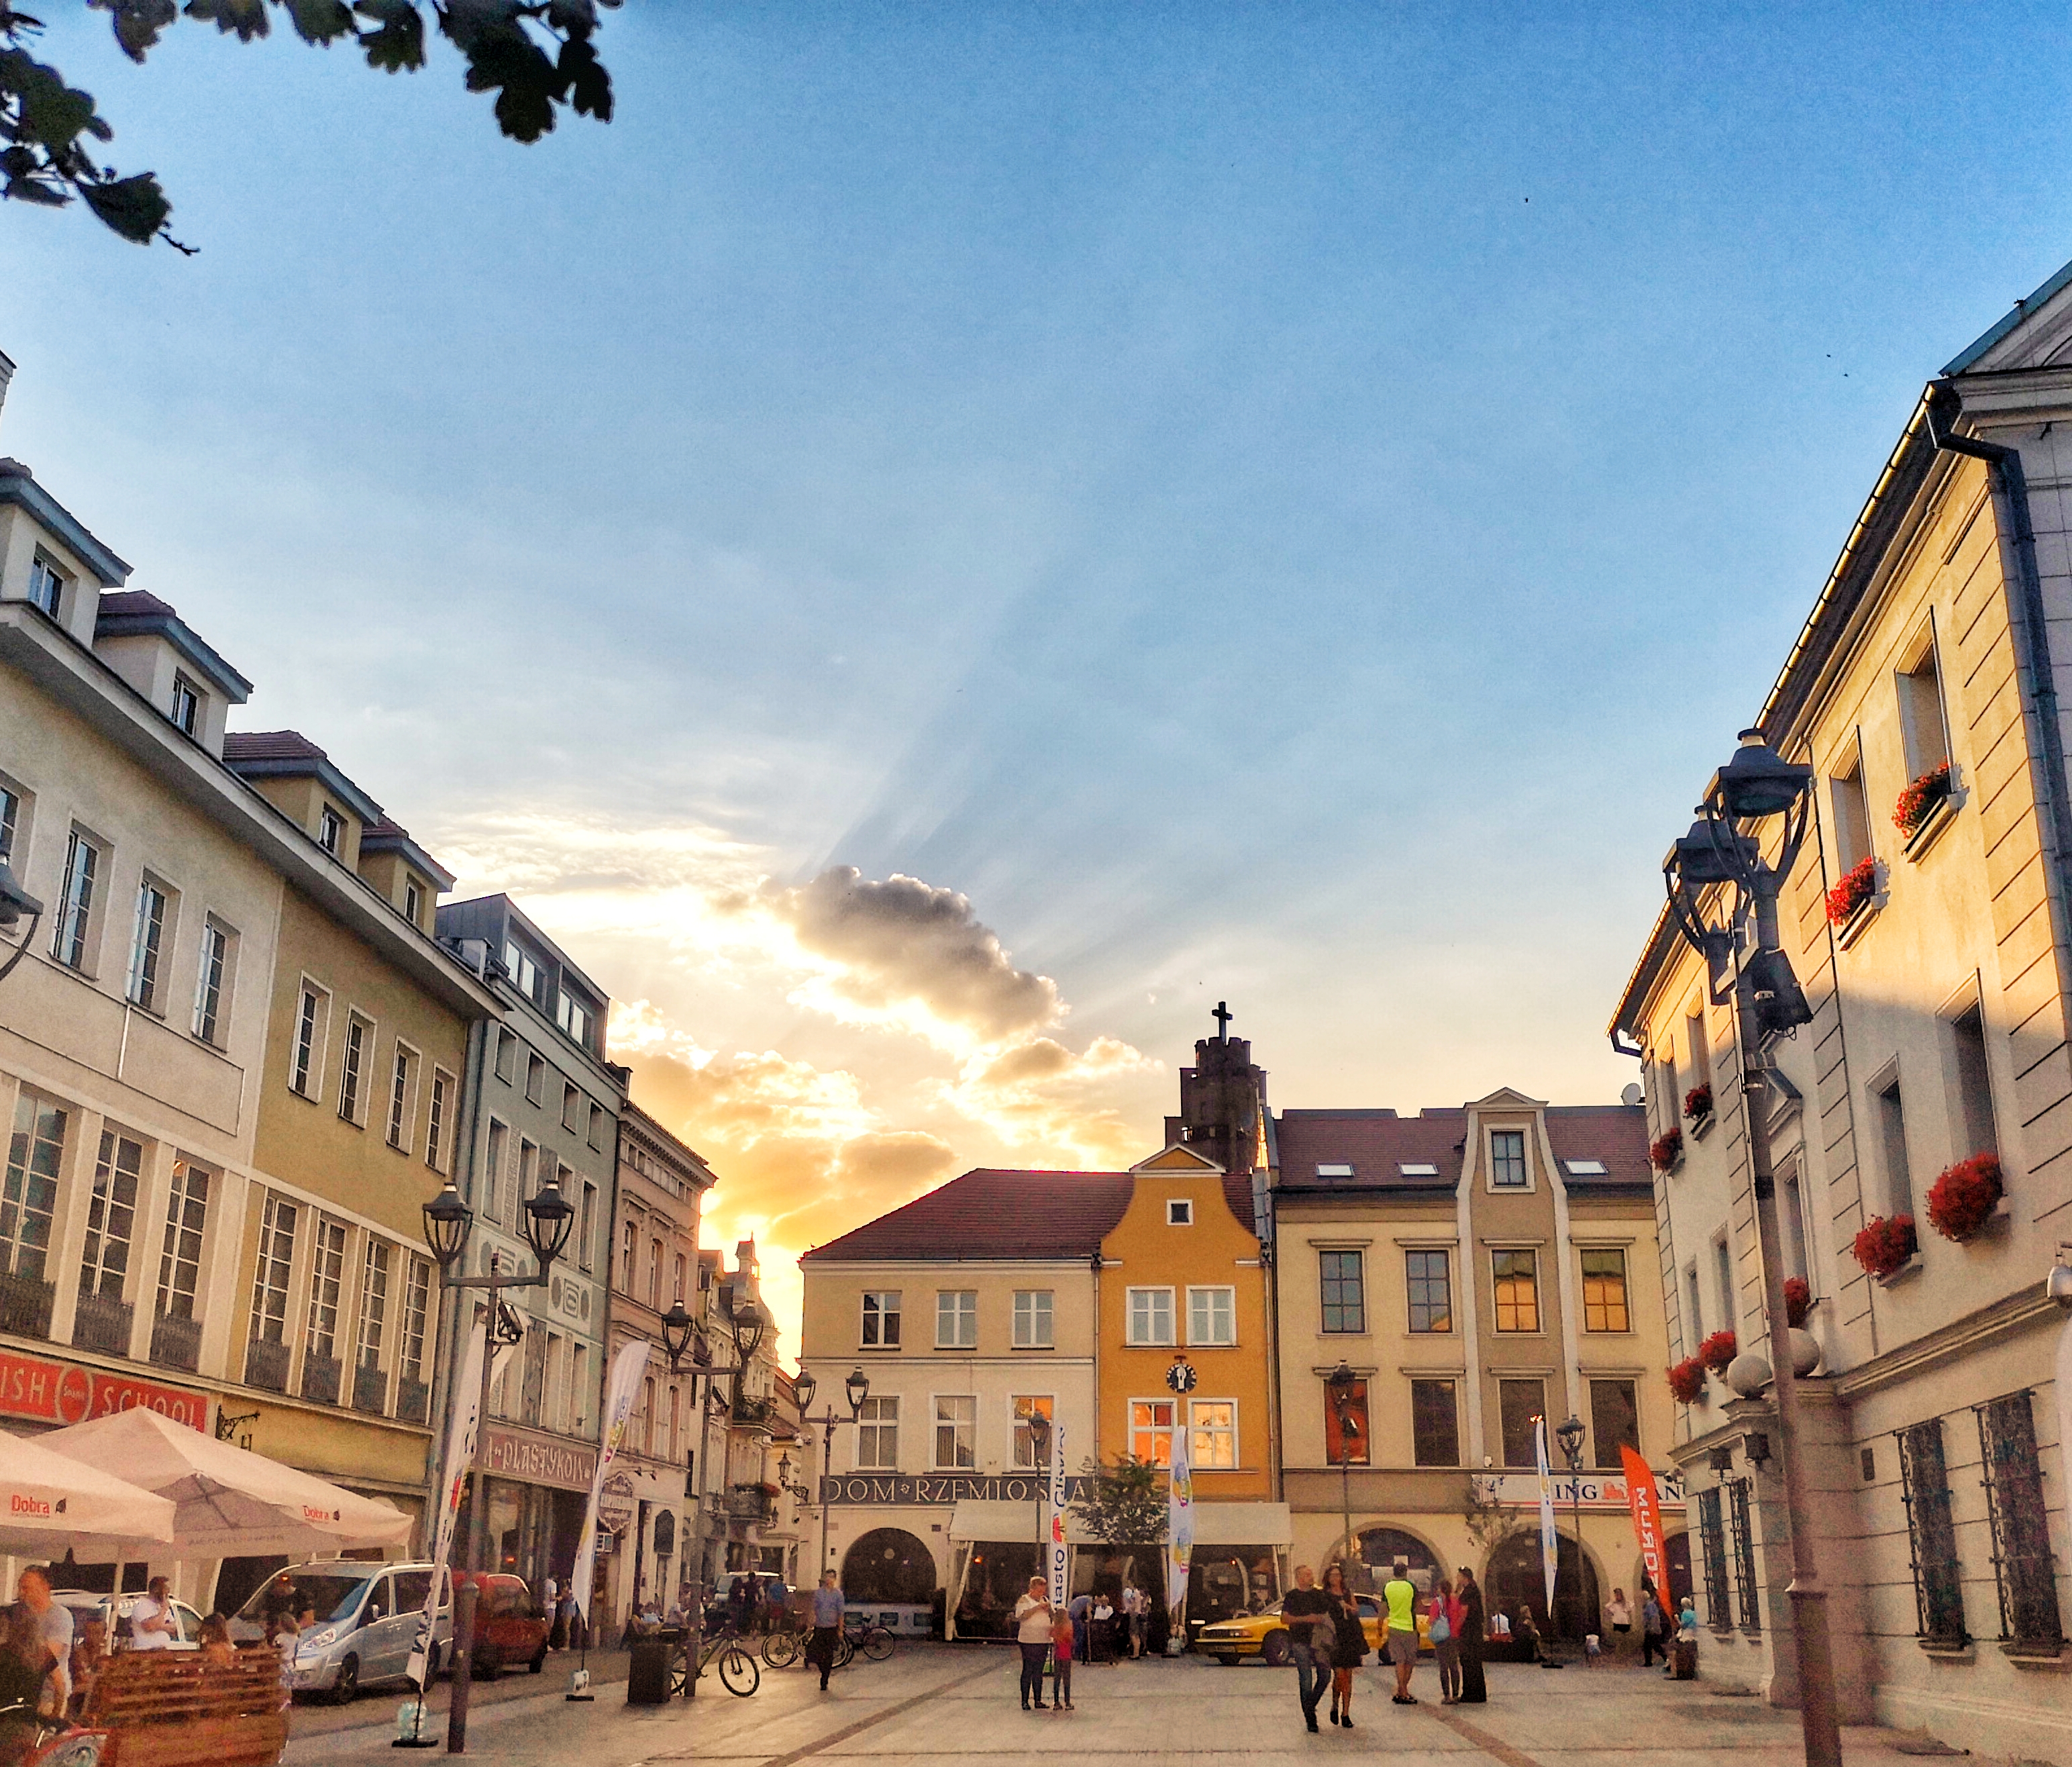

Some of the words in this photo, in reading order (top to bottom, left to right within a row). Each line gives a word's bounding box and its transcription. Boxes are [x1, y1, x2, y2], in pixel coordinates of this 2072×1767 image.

[823, 1478, 895, 1502] DOM
[915, 1478, 1086, 1502] RZEMIOSA
[1554, 1484, 1598, 1500] ING
[11, 1495, 50, 1513] Dobra
[1053, 1548, 1066, 1606] iasto
